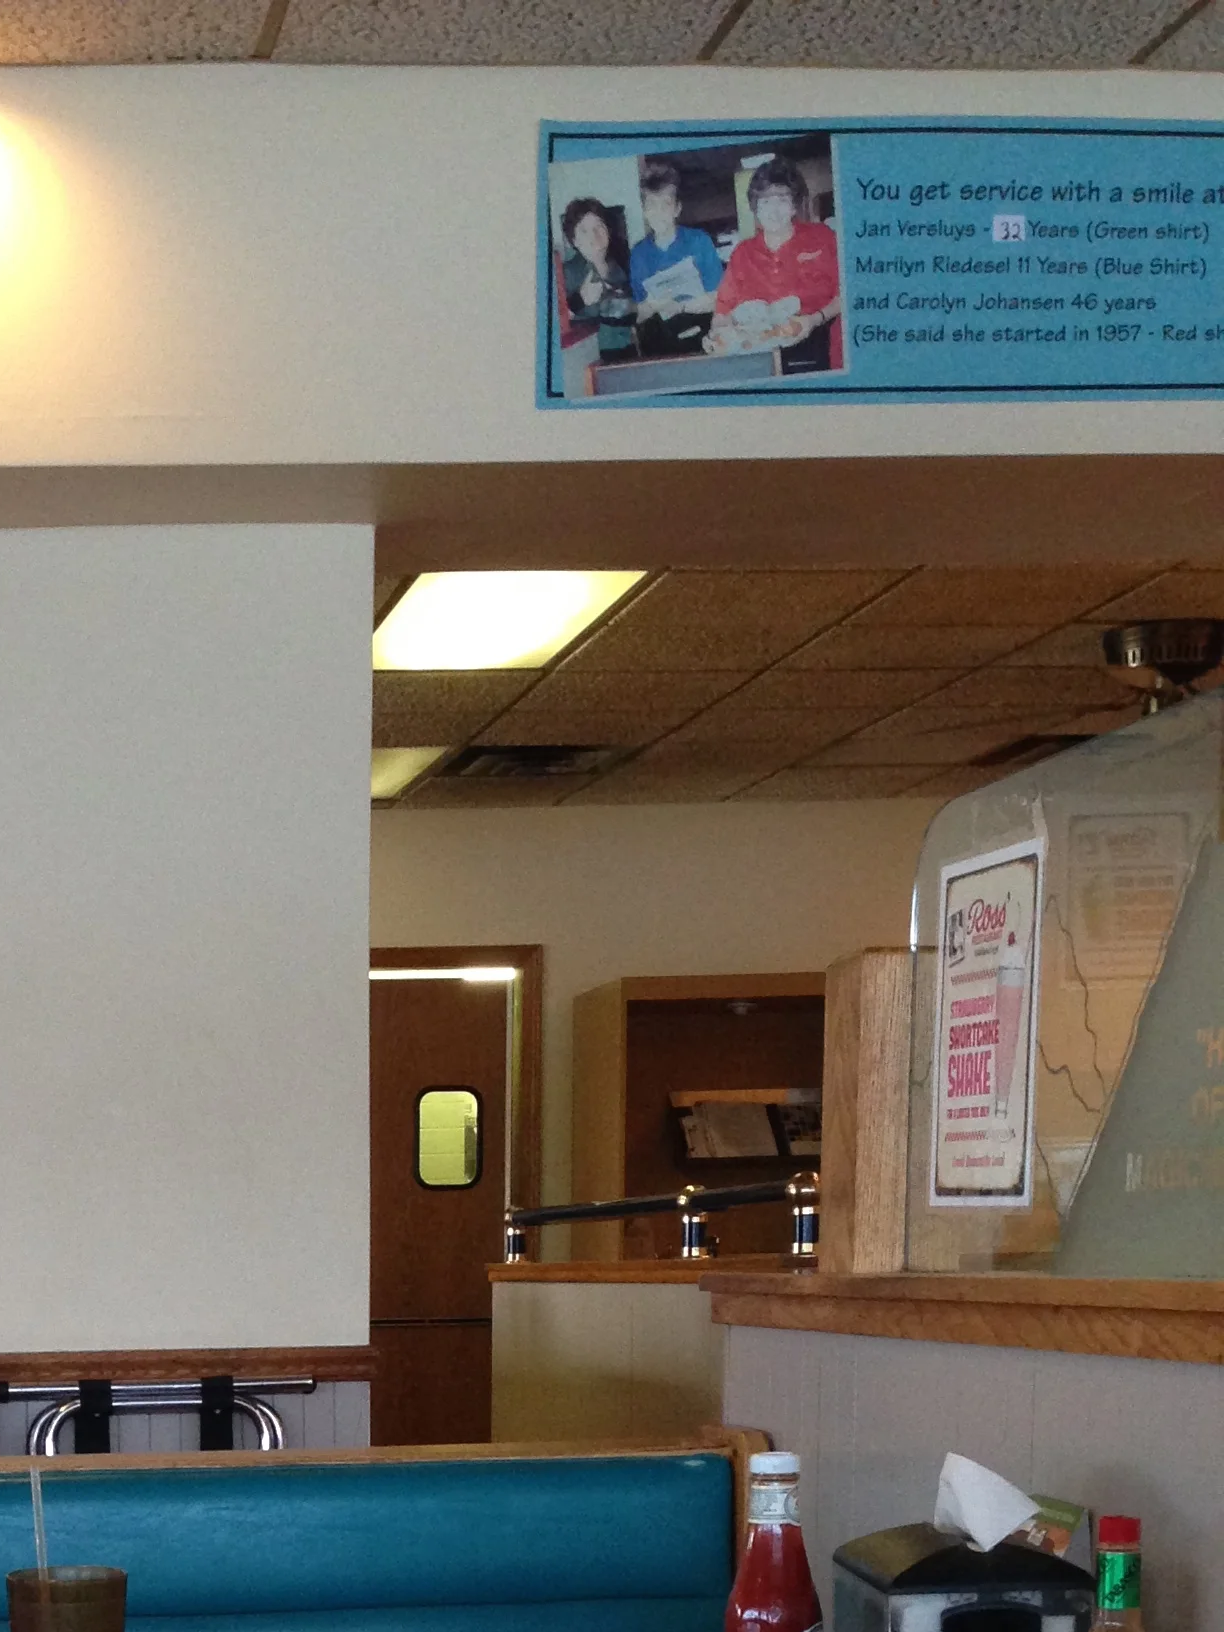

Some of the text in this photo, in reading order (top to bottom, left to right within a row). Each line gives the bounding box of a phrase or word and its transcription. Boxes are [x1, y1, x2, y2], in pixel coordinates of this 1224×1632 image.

[857, 178, 900, 201] You
[910, 180, 950, 206] get
[960, 179, 1043, 201] service
[1052, 180, 1100, 202] with
[1110, 186, 1122, 202] a
[1132, 182, 1194, 204] smile
[856, 220, 891, 237] Jan
[898, 220, 975, 241] Versluys
[1000, 222, 1022, 240] 32
[1028, 221, 1079, 237] Years
[1087, 221, 1148, 242] (Green
[1156, 222, 1209, 243] shirt)
[856, 256, 925, 277] Marilyn
[932, 256, 1009, 274] Riedesel
[1038, 259, 1088, 274] Years
[1095, 259, 1143, 278] (Blue
[1150, 259, 1207, 279] Shirt)
[853, 293, 1156, 315] and Carolyn Johansen 46 years
[853, 325, 898, 346] (She
[905, 325, 944, 342] said
[953, 325, 985, 342] she
[992, 325, 1066, 342] started
[1075, 326, 1088, 342] in
[1097, 325, 1141, 341] 1957
[1163, 326, 1204, 342] Red
[947, 1050, 992, 1098] SHAKE
